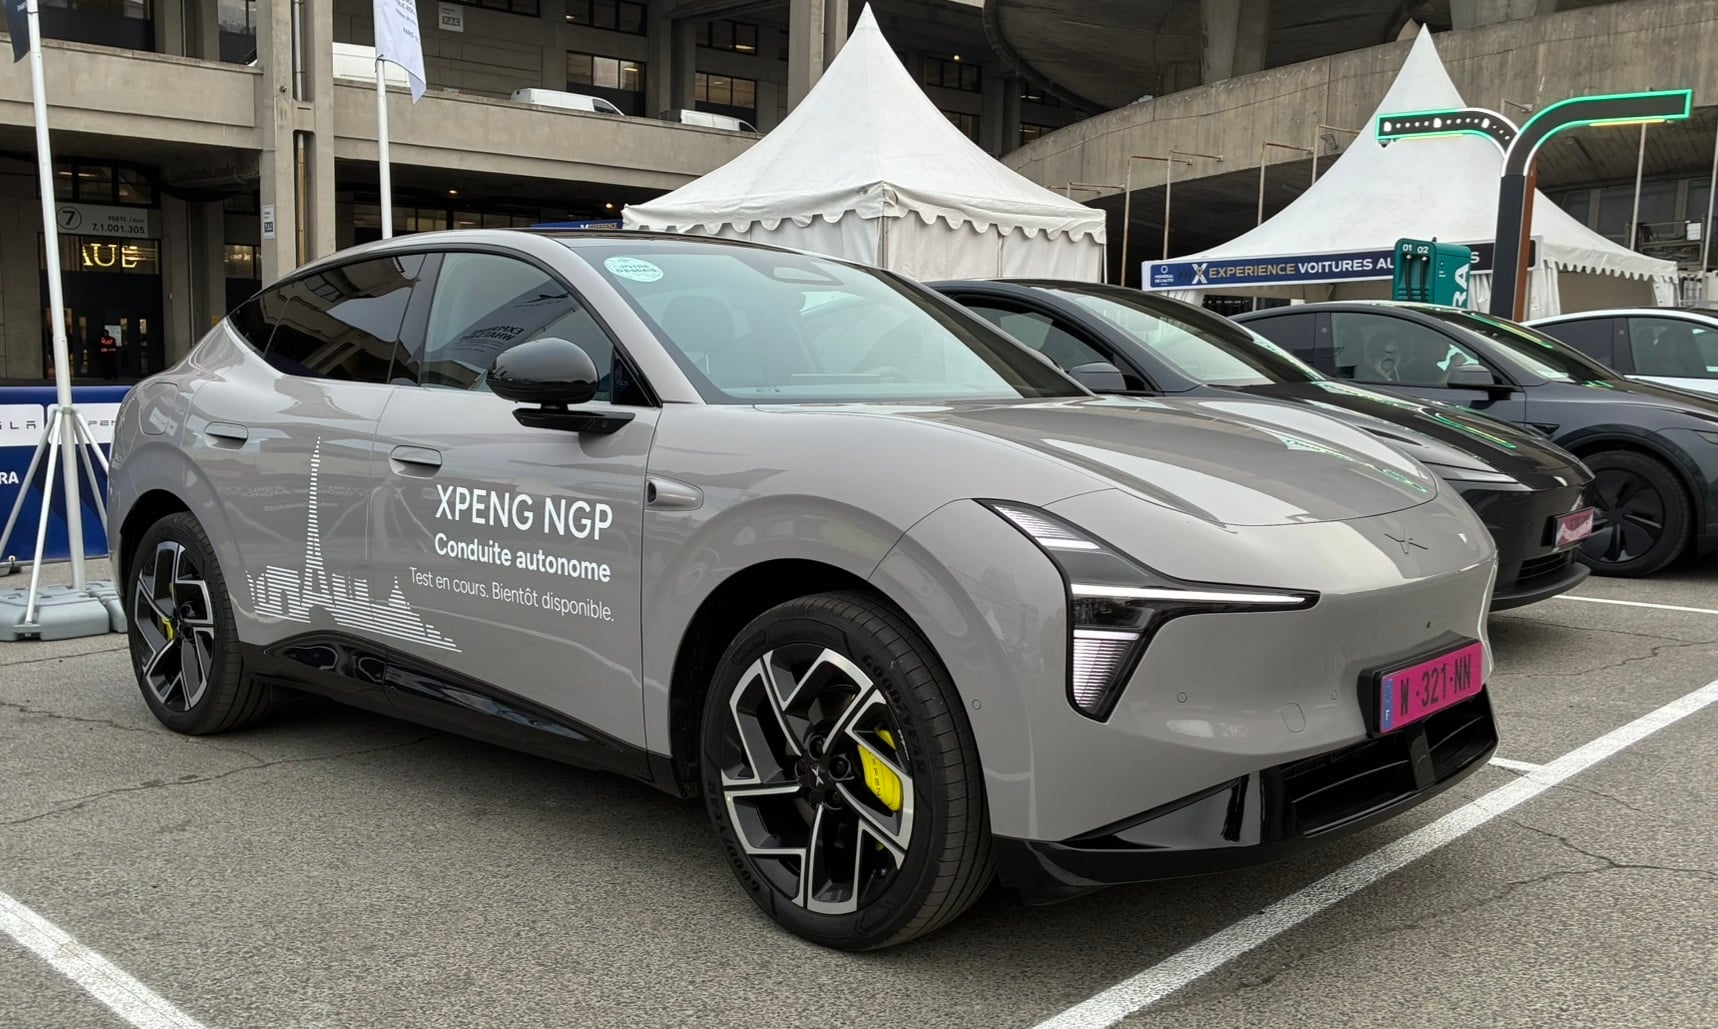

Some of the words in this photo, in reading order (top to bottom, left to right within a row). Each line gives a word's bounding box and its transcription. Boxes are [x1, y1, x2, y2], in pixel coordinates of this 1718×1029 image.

[62, 210, 76, 226] 7
[92, 223, 145, 234] 7.1.001.305
[1403, 244, 1413, 252] 01
[1417, 246, 1429, 254] 02
[1209, 264, 1296, 279] EXPERIENCE
[1298, 258, 1374, 274] VOITURES
[434, 484, 534, 531] XPENG
[544, 496, 613, 541] NGP
[434, 532, 512, 566] Conduite
[516, 549, 611, 583] autonome
[409, 566, 433, 588] Test
[436, 575, 450, 591] en
[453, 577, 489, 598] cours.
[492, 581, 538, 608] Bientôt
[542, 592, 614, 622] disponible.
